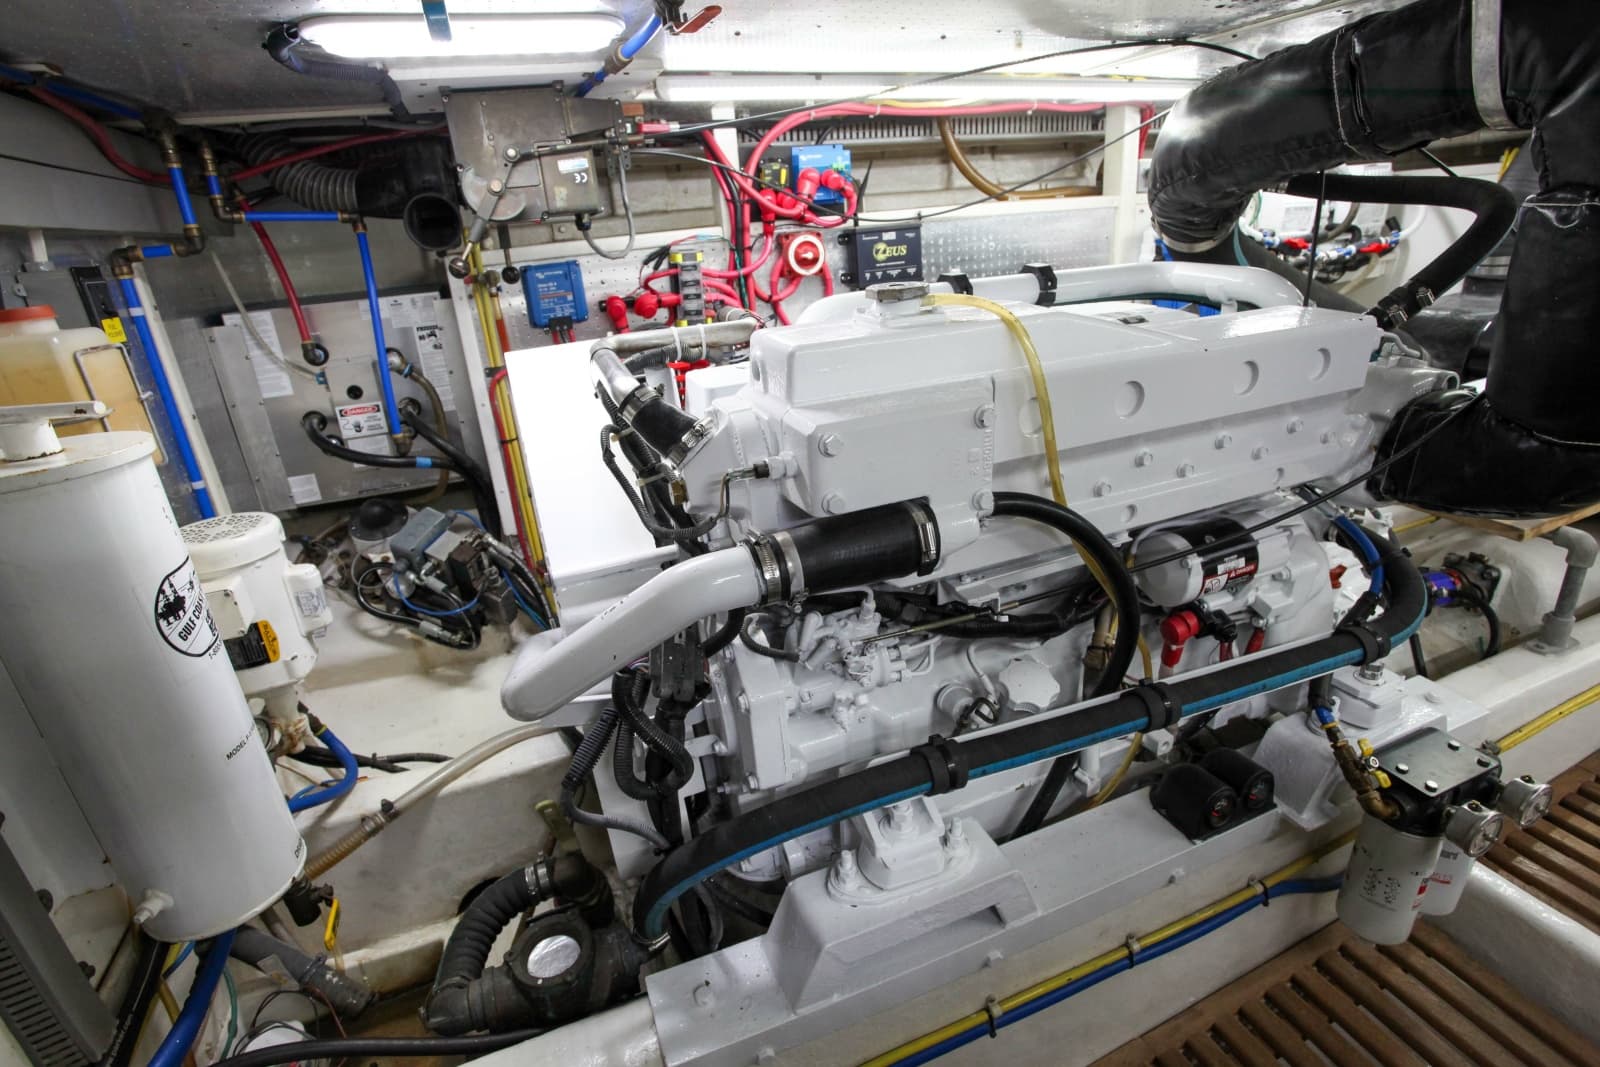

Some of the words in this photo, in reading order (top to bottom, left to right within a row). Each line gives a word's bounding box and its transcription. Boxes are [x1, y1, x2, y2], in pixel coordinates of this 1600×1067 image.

[873, 244, 908, 258] ZEUS
[178, 617, 197, 641] GULF
[226, 739, 246, 760] MODEL
